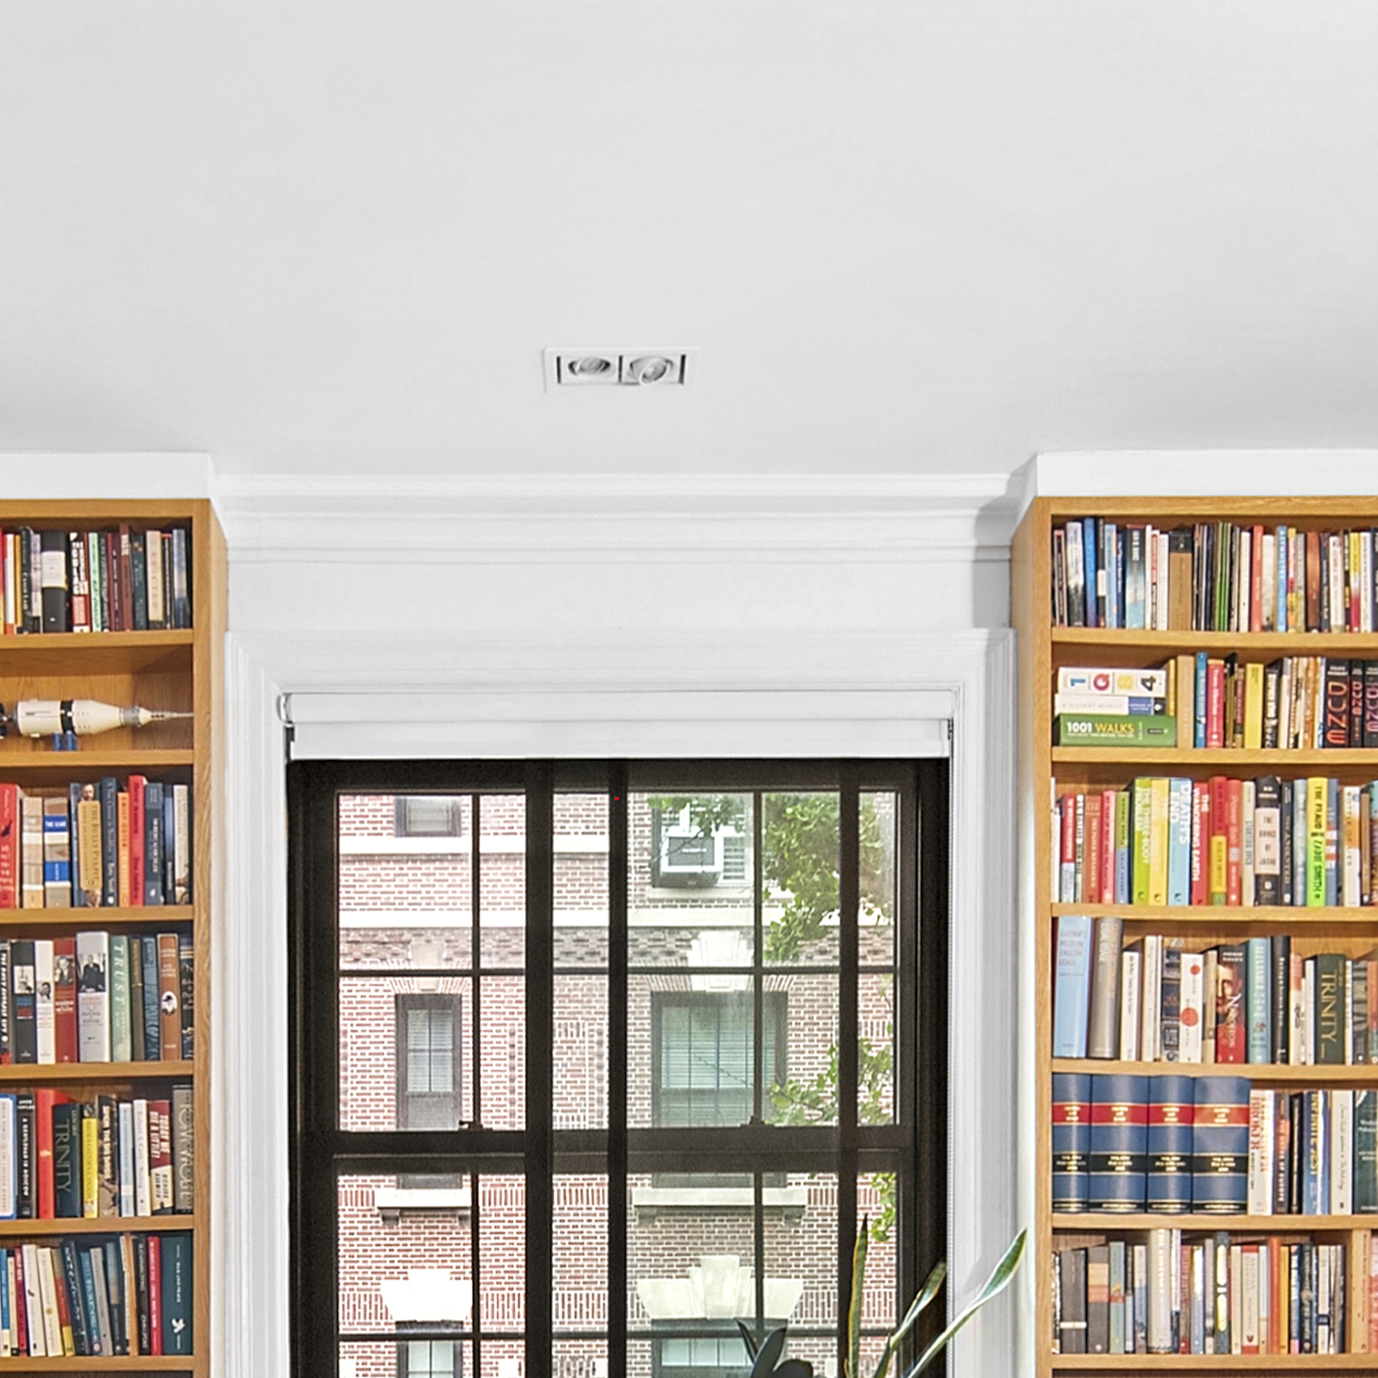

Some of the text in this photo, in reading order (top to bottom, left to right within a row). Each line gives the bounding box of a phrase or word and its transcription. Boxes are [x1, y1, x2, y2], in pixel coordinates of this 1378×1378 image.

[1067, 722, 1134, 732] 1001 WALKS
[1170, 791, 1179, 823] END
[1180, 784, 1190, 844] DEATH'S
[1192, 787, 1200, 882] WANDERING EARTH
[1313, 864, 1322, 891] SMITH
[1314, 840, 1322, 862] ZADIE
[114, 945, 125, 1005] TRUST
[1321, 970, 1337, 1042] TRINITY
[55, 1118, 71, 1192] TRINITY
[1310, 1093, 1318, 1175] INFINITE JEST
